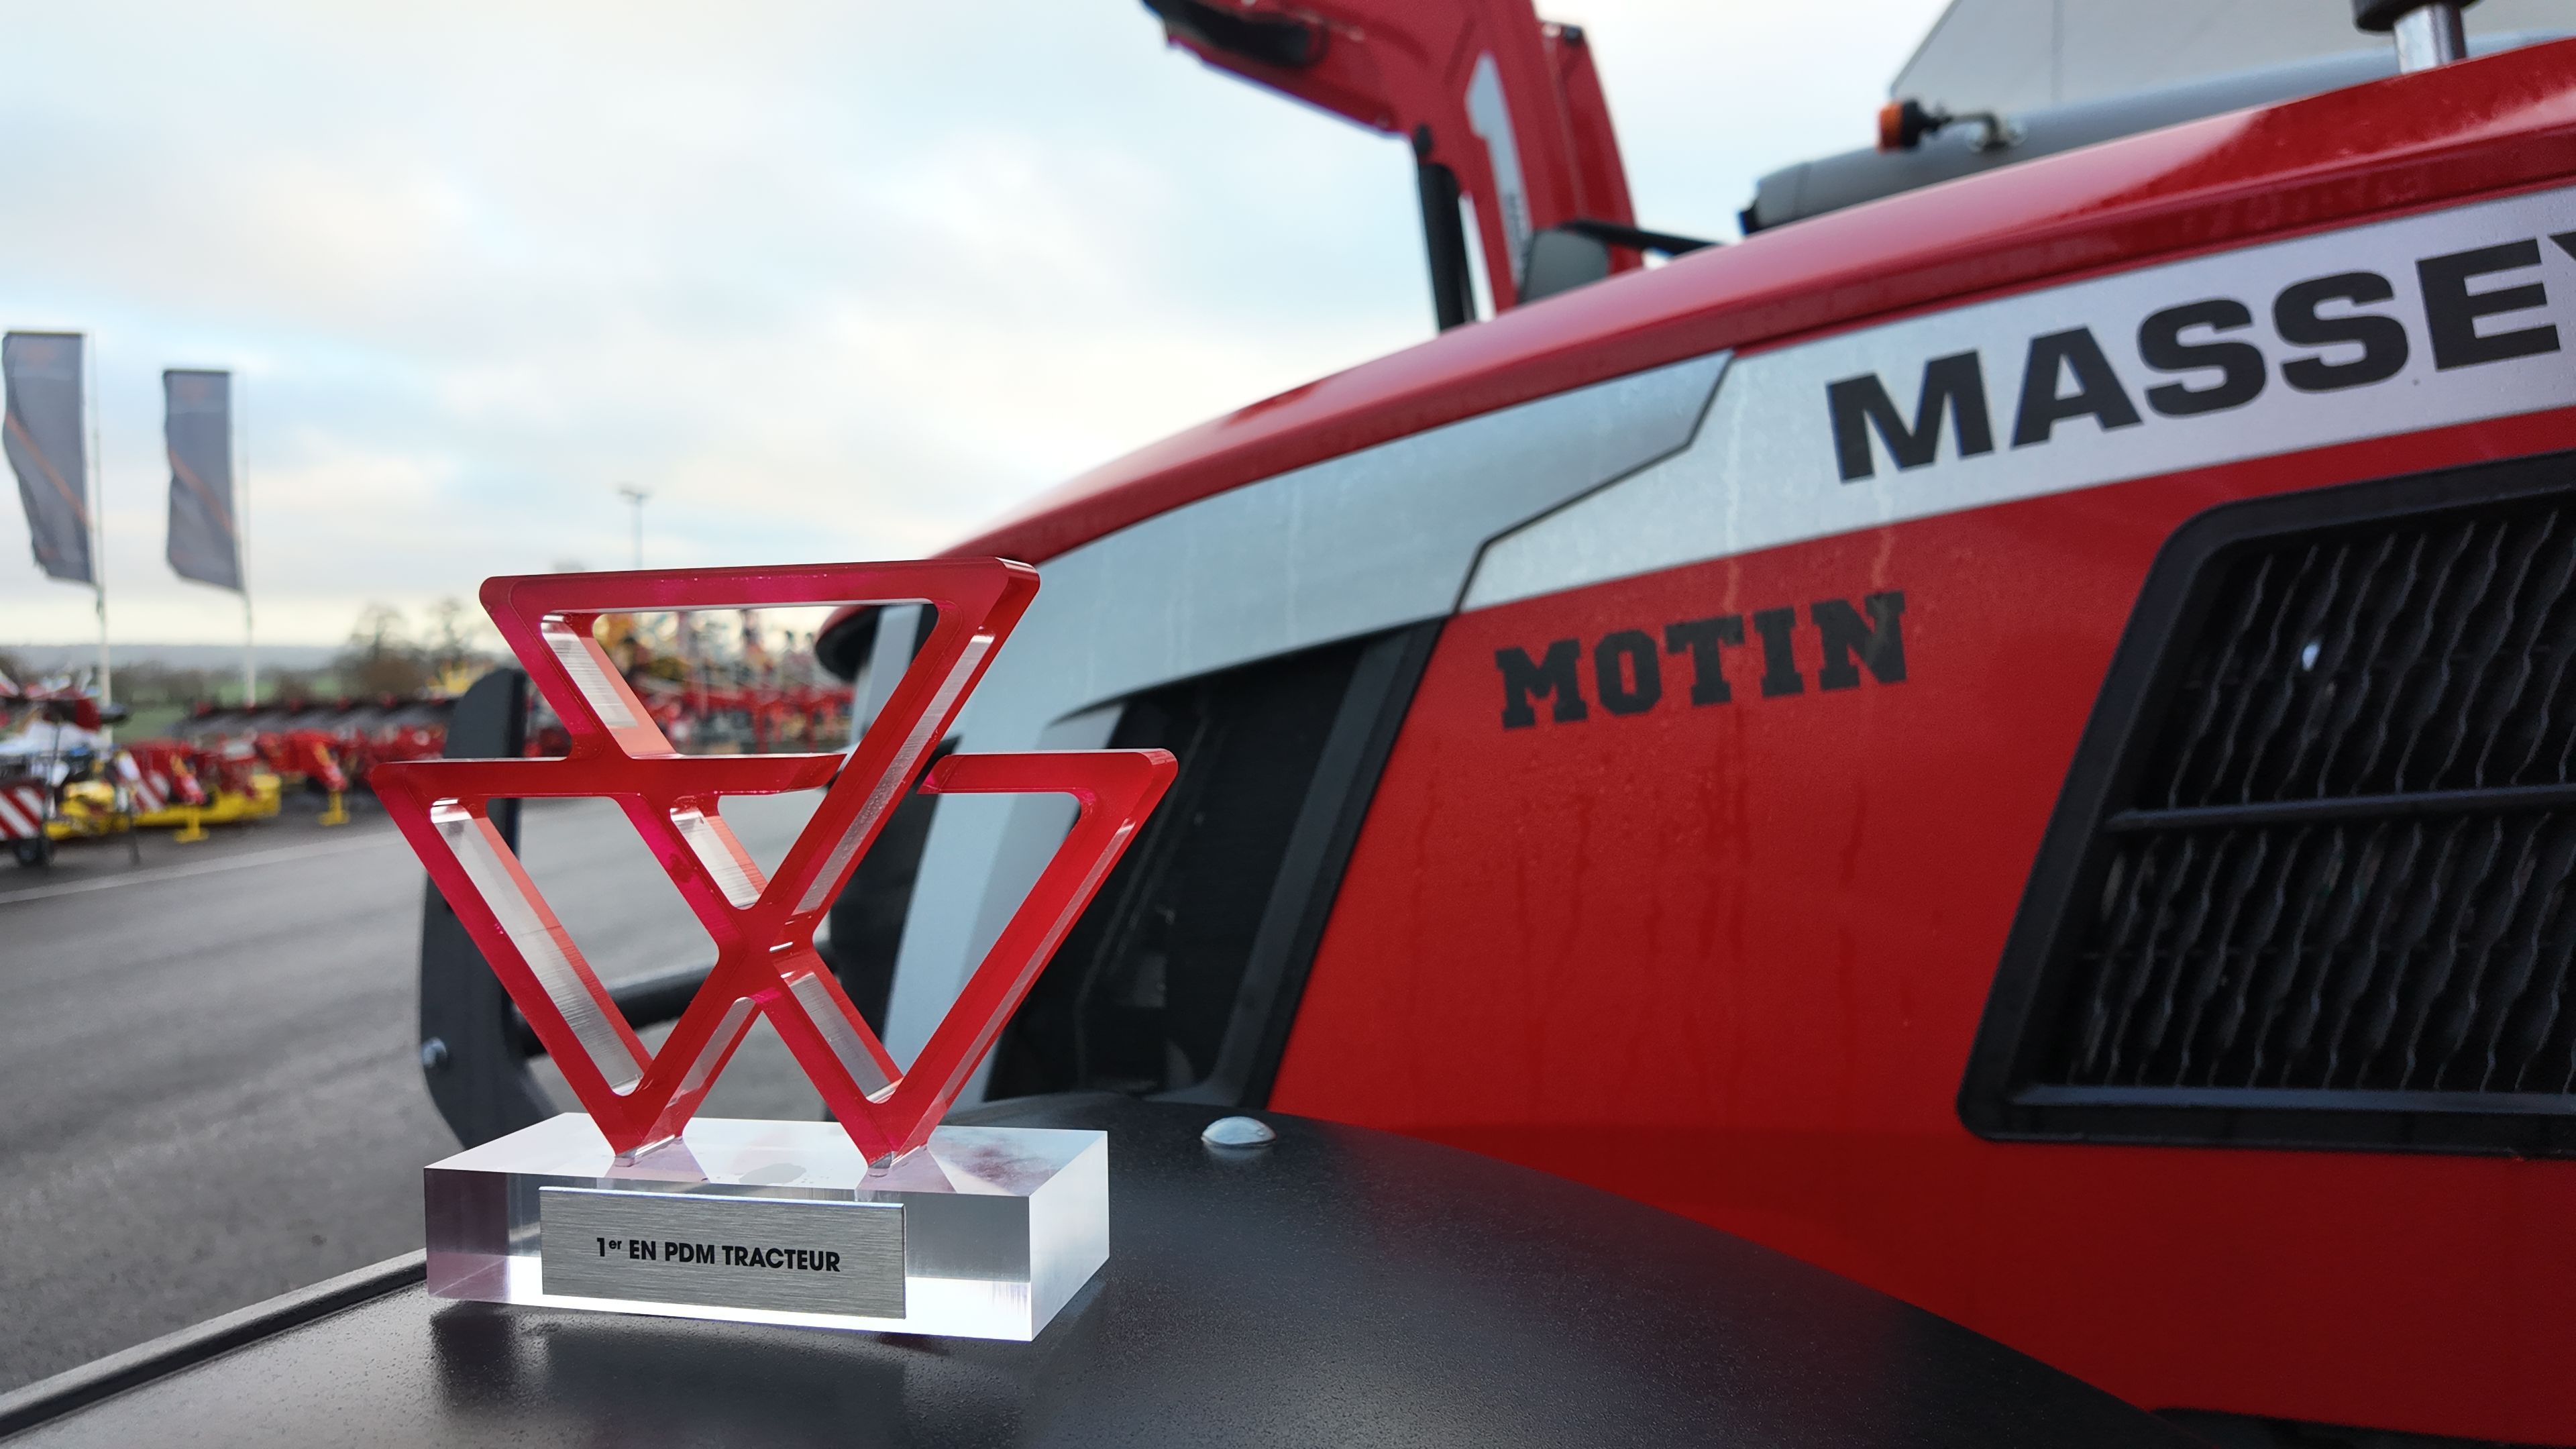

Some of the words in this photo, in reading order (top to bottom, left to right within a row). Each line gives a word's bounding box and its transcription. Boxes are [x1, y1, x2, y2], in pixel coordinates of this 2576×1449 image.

[1825, 231, 2576, 484] MASSE
[1495, 590, 1907, 730] MOTIN
[596, 1237, 623, 1257] 1er
[629, 1240, 656, 1260] EN
[665, 1242, 715, 1265] PDM
[722, 1245, 841, 1273] TRACTEUR
